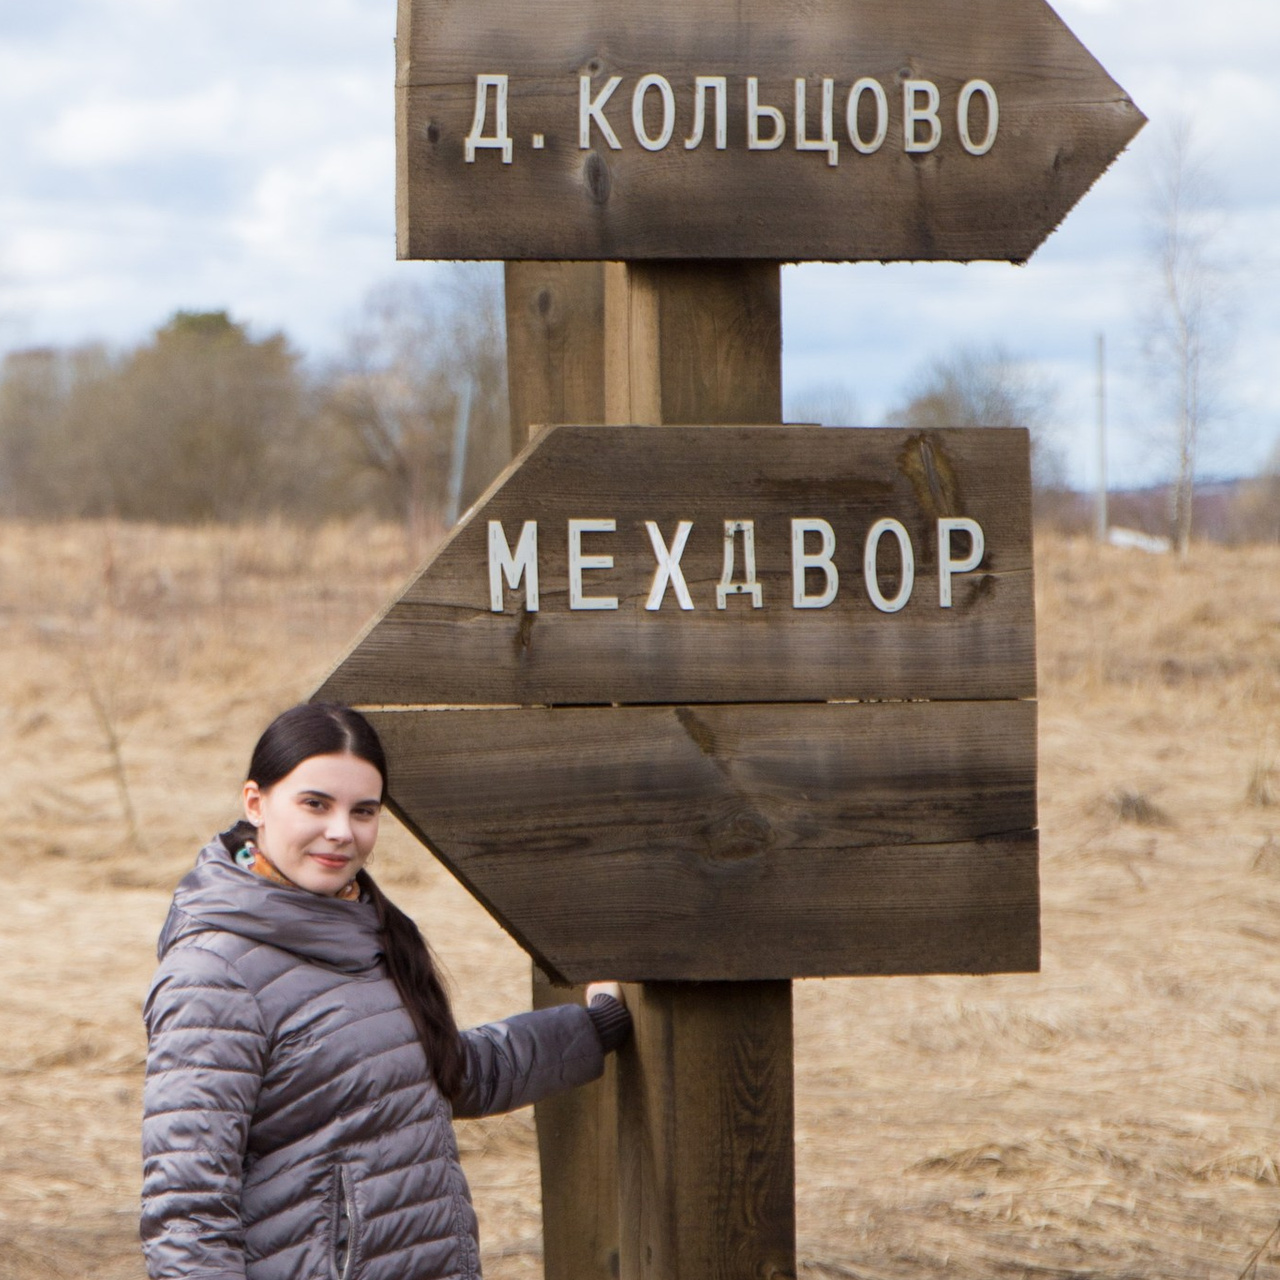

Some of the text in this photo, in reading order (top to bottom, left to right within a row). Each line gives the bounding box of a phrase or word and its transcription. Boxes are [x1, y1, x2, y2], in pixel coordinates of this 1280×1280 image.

[464, 73, 1000, 166] Д. КОЛЬЦОВО
[487, 517, 985, 613] МЕХДВОР
